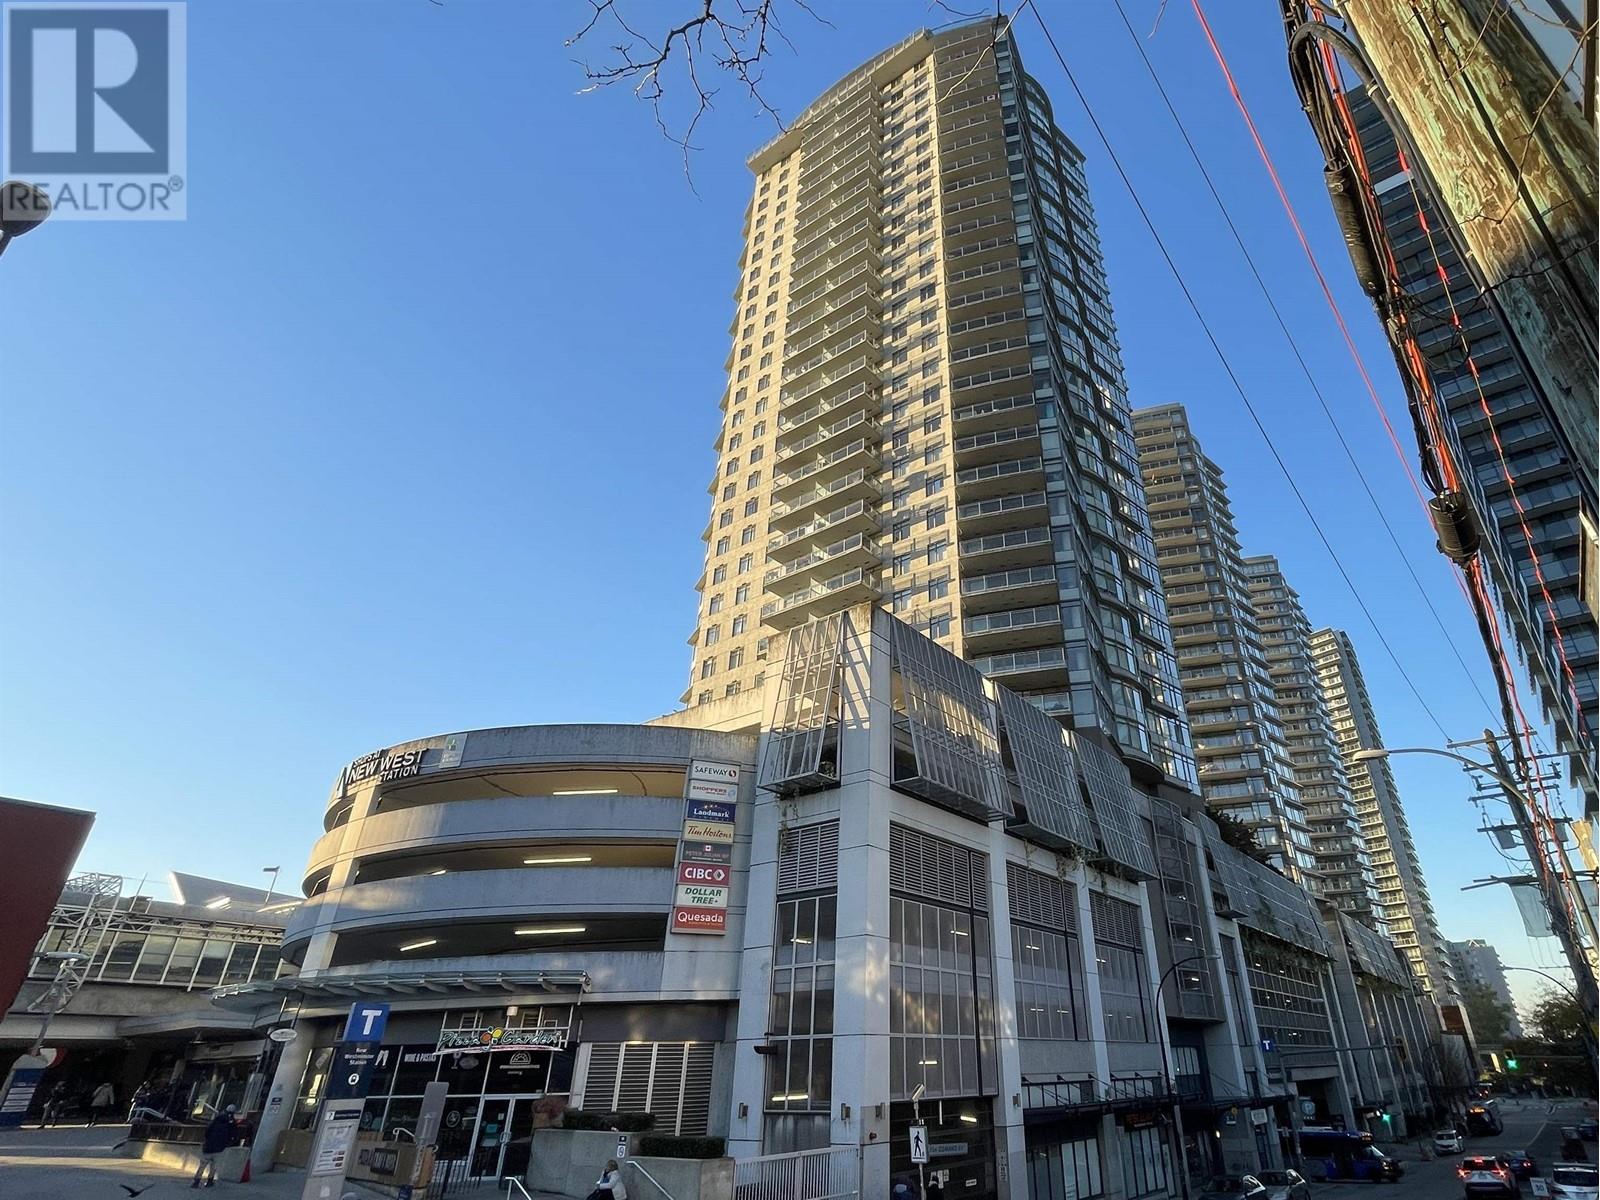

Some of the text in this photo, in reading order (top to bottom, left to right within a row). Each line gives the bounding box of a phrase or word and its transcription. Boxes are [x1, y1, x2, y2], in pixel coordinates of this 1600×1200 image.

[348, 759, 380, 784] NEW
[380, 748, 428, 771] WEST
[694, 766, 728, 776] SAFEWAY
[380, 764, 418, 782] STATION
[693, 808, 729, 818] Landmark
[688, 825, 732, 838] Tim Hortons
[685, 867, 713, 880] CIBC
[685, 887, 722, 896] DOLLAR
[691, 896, 715, 904] TREE
[677, 911, 723, 923] Quesada
[361, 1009, 383, 1035] T
[440, 1029, 560, 1047] Pizza Garden
